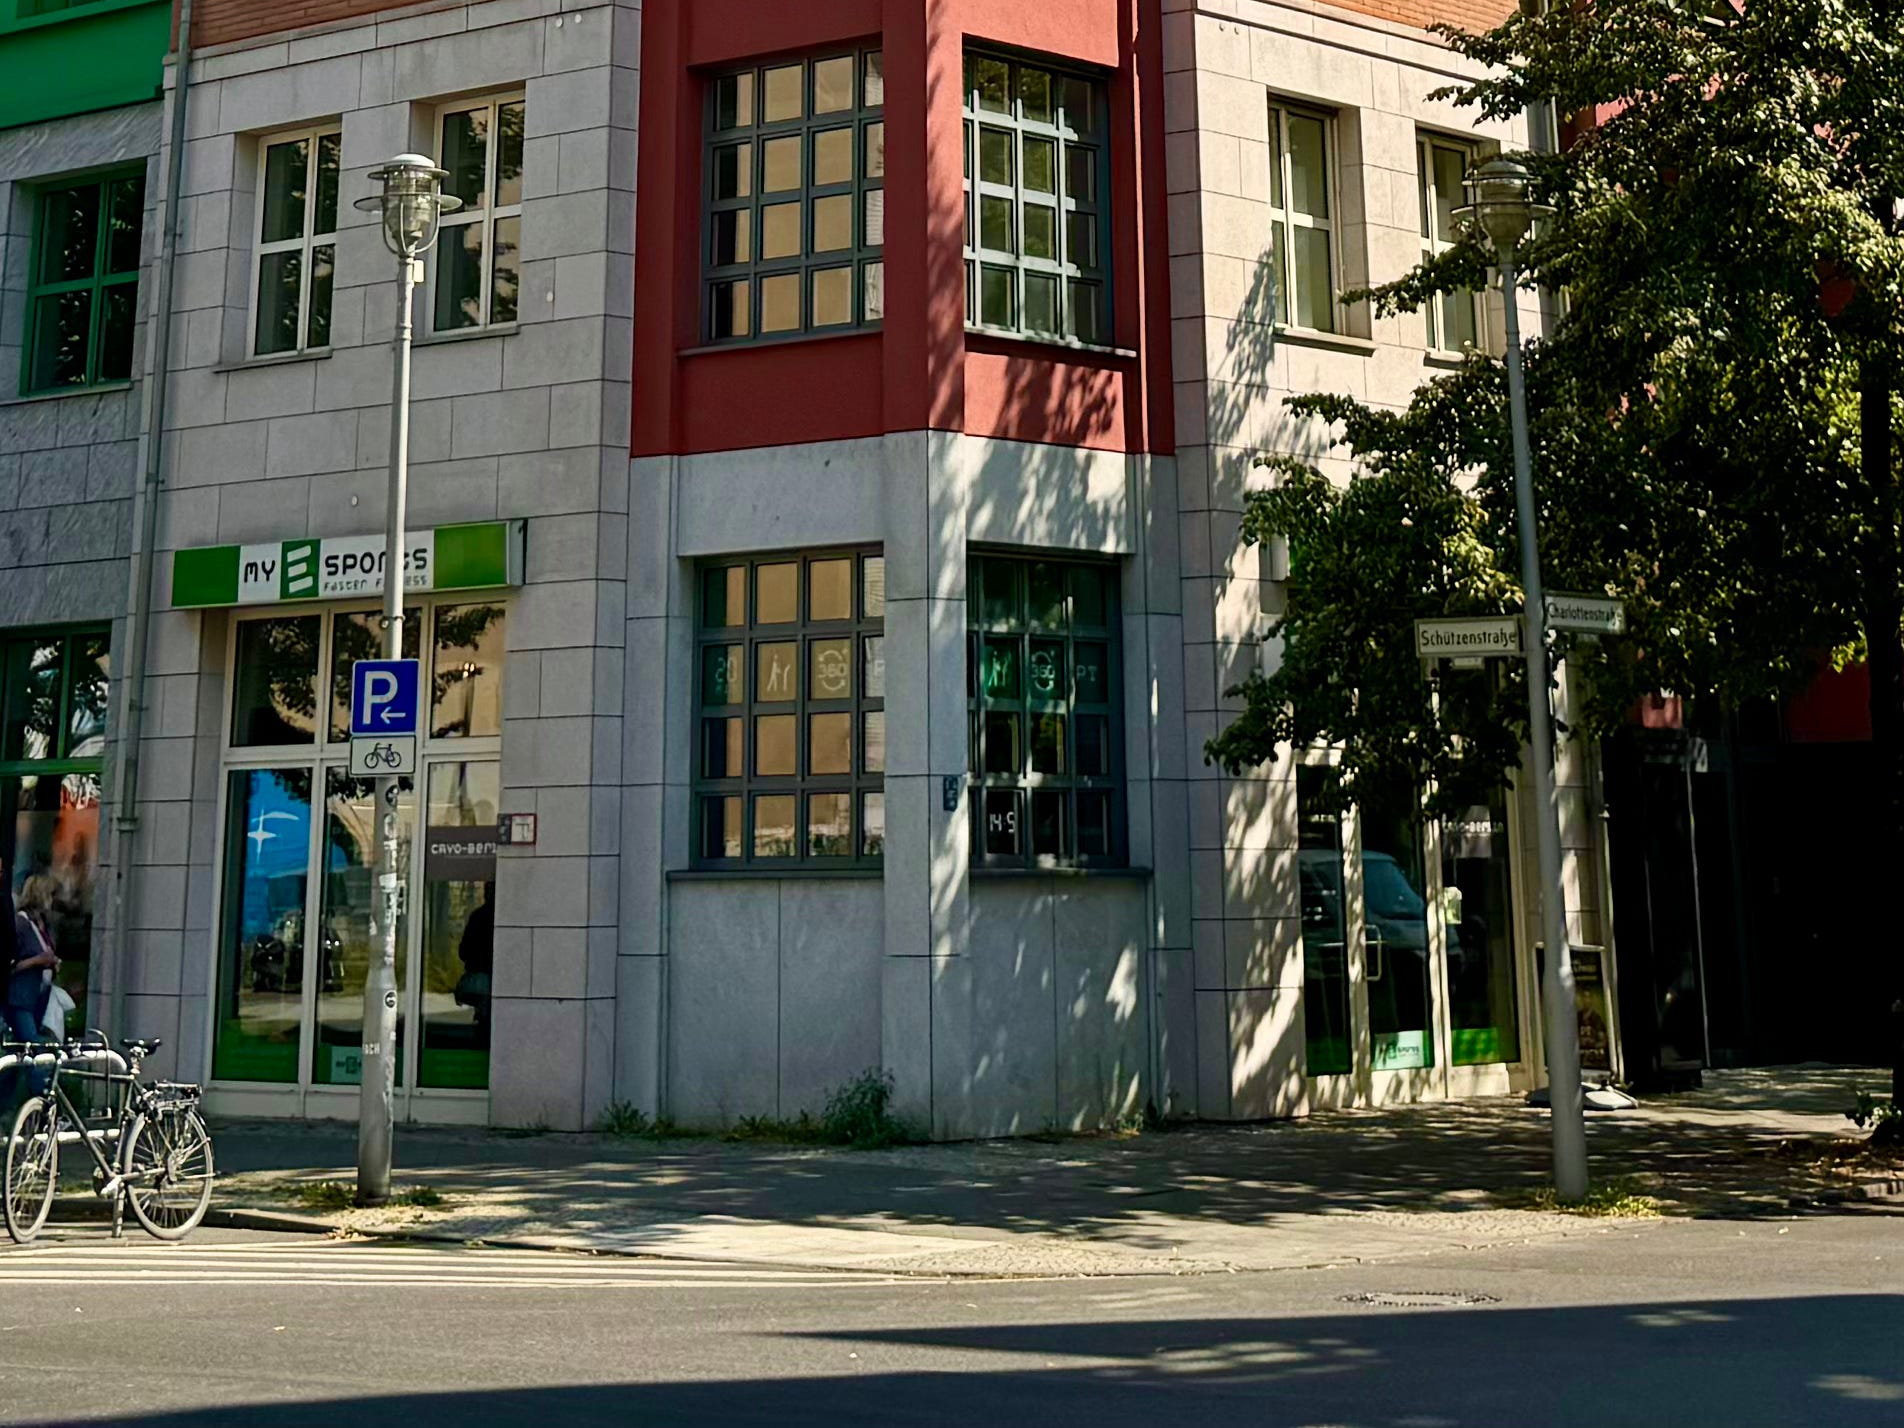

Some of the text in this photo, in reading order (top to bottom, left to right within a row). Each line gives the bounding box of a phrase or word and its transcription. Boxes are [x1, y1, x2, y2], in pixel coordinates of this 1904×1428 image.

[243, 559, 276, 583] MY
[1420, 627, 1516, 648] Schützenstraße
[362, 670, 399, 726] P
